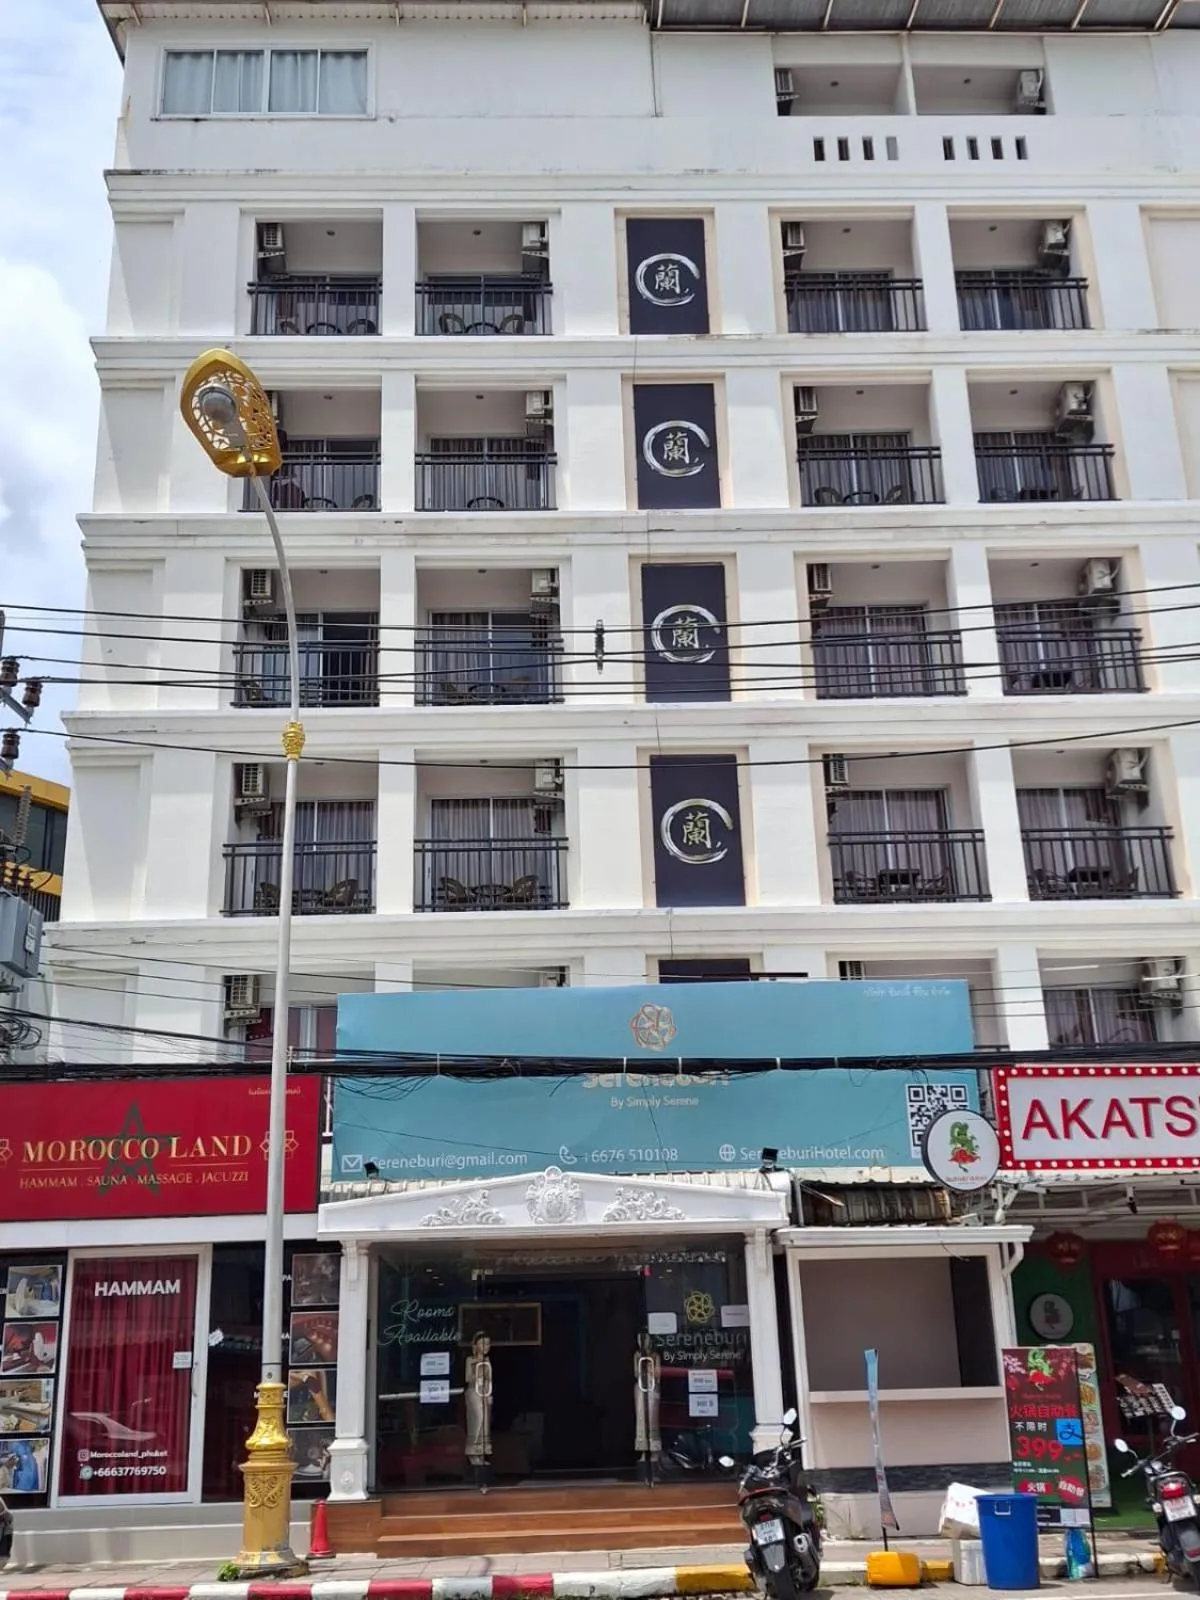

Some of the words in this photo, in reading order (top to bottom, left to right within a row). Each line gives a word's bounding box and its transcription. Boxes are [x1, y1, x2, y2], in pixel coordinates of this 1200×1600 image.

[611, 1097, 624, 1109] By
[626, 1096, 661, 1109] Simply
[663, 1095, 699, 1106] Serene
[1022, 1095, 1200, 1140] AKATS
[21, 1138, 160, 1164] MOROCCO
[169, 1135, 252, 1158] LAND
[628, 1148, 679, 1161] 510108
[19, 1177, 78, 1190] HAMMAM
[87, 1175, 129, 1187] SAUNA
[136, 1172, 193, 1185] MASSAGE
[199, 1171, 249, 1184] JACUZZI
[94, 1279, 181, 1297] HAMMAM
[663, 1351, 675, 1363] By
[90, 1450, 168, 1459] Moroccoland_phuket
